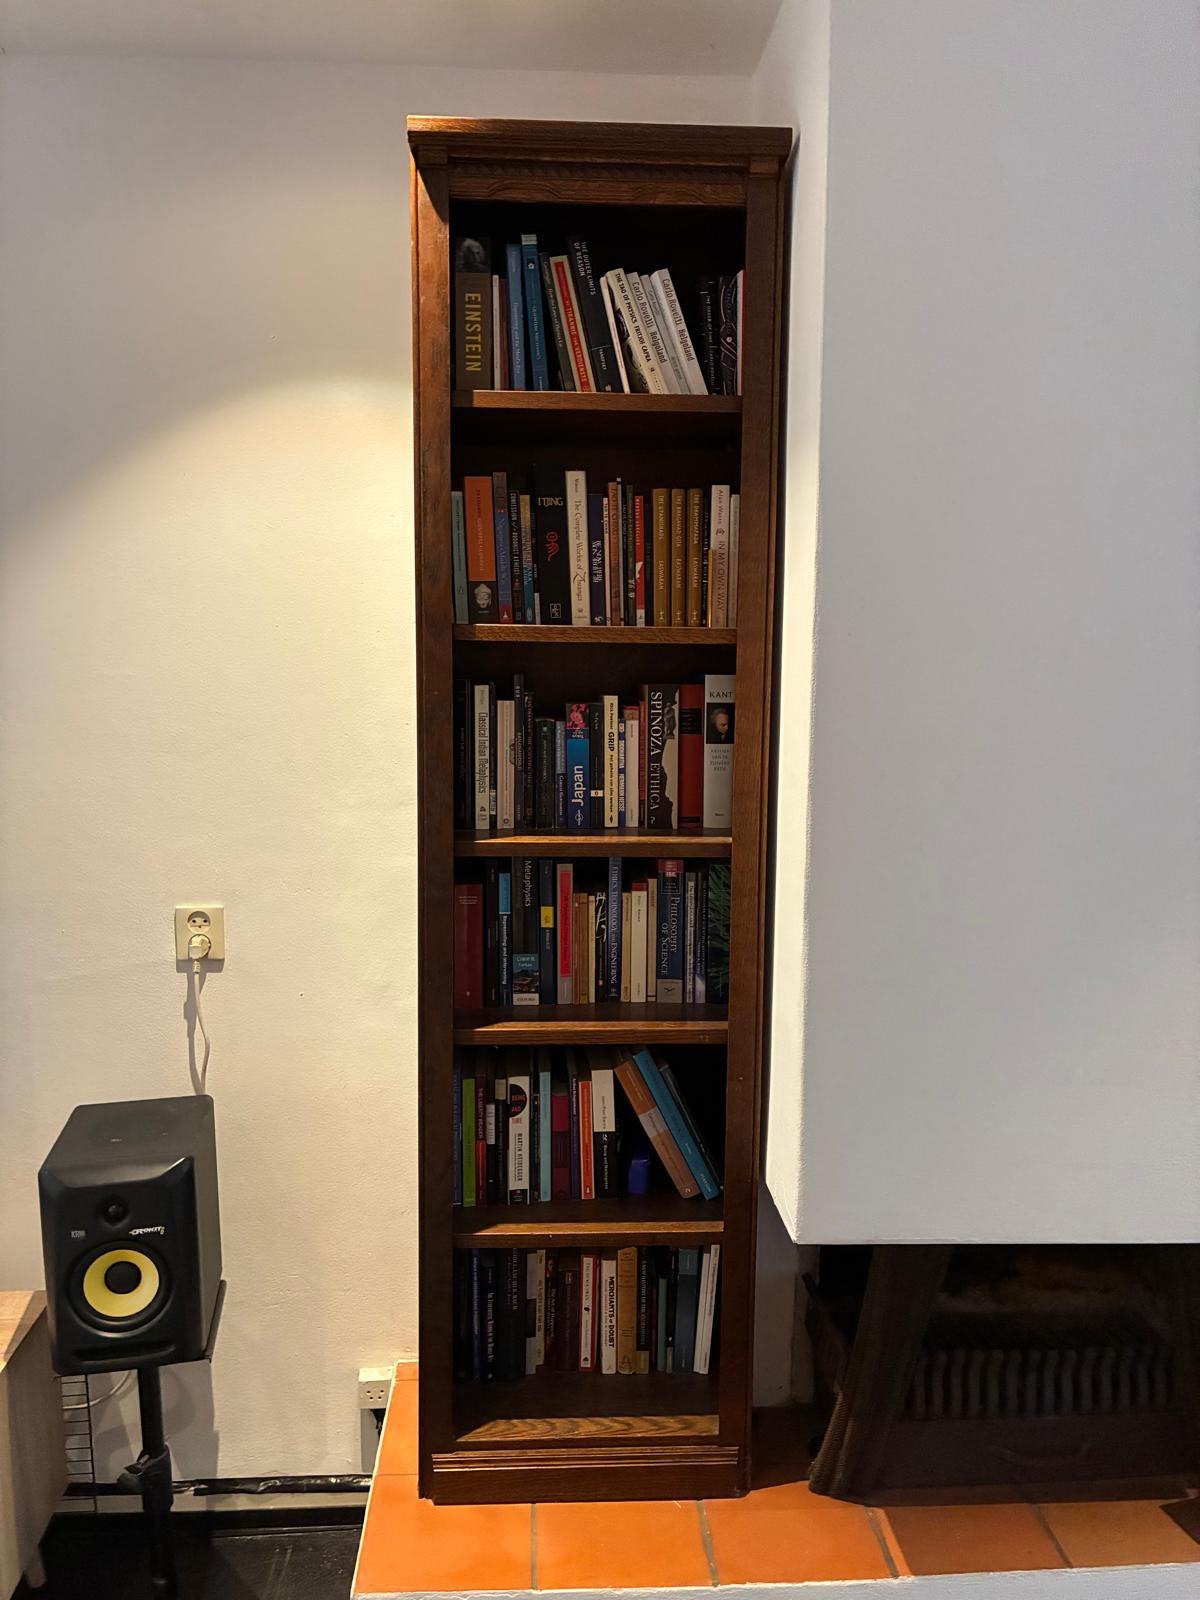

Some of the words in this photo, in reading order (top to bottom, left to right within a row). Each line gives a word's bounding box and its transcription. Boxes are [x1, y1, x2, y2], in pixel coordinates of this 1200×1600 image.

[573, 241, 580, 249] OF
[574, 251, 586, 276] REASON
[582, 254, 592, 274] OUTER
[586, 274, 597, 295] LIMITS
[614, 272, 622, 283] THE
[618, 282, 626, 294] TAO
[661, 277, 675, 297] Carlo
[622, 293, 629, 301] OF
[624, 301, 637, 324] PHYSICS
[631, 281, 644, 301] Carlo
[638, 300, 654, 328] Rovelli
[648, 330, 667, 364] Helgoland
[667, 297, 684, 325] Rovelli
[465, 293, 482, 372] EINSTEIN
[640, 344, 651, 362] CAPRA
[675, 327, 695, 362] Helgoland
[510, 492, 518, 520] CONFESSION
[574, 512, 582, 539] Complete
[512, 531, 520, 554] BUDDHIST
[575, 542, 583, 563] Works
[718, 541, 725, 549] IN
[513, 555, 521, 574] ATHEIST
[717, 552, 725, 566] MY
[717, 568, 725, 590] OWN
[716, 592, 724, 610] WAY
[478, 712, 488, 737] Classical
[650, 691, 662, 755] SPINOZA
[478, 739, 488, 756] Indian
[475, 758, 488, 793] Metaphysics
[571, 765, 586, 806] Japan
[650, 762, 659, 810] ETHICA
[522, 859, 532, 906] Metaphysics
[661, 922, 668, 934] OF
[669, 896, 680, 952] PHILOSOPHY
[660, 936, 670, 976] SCIENCE
